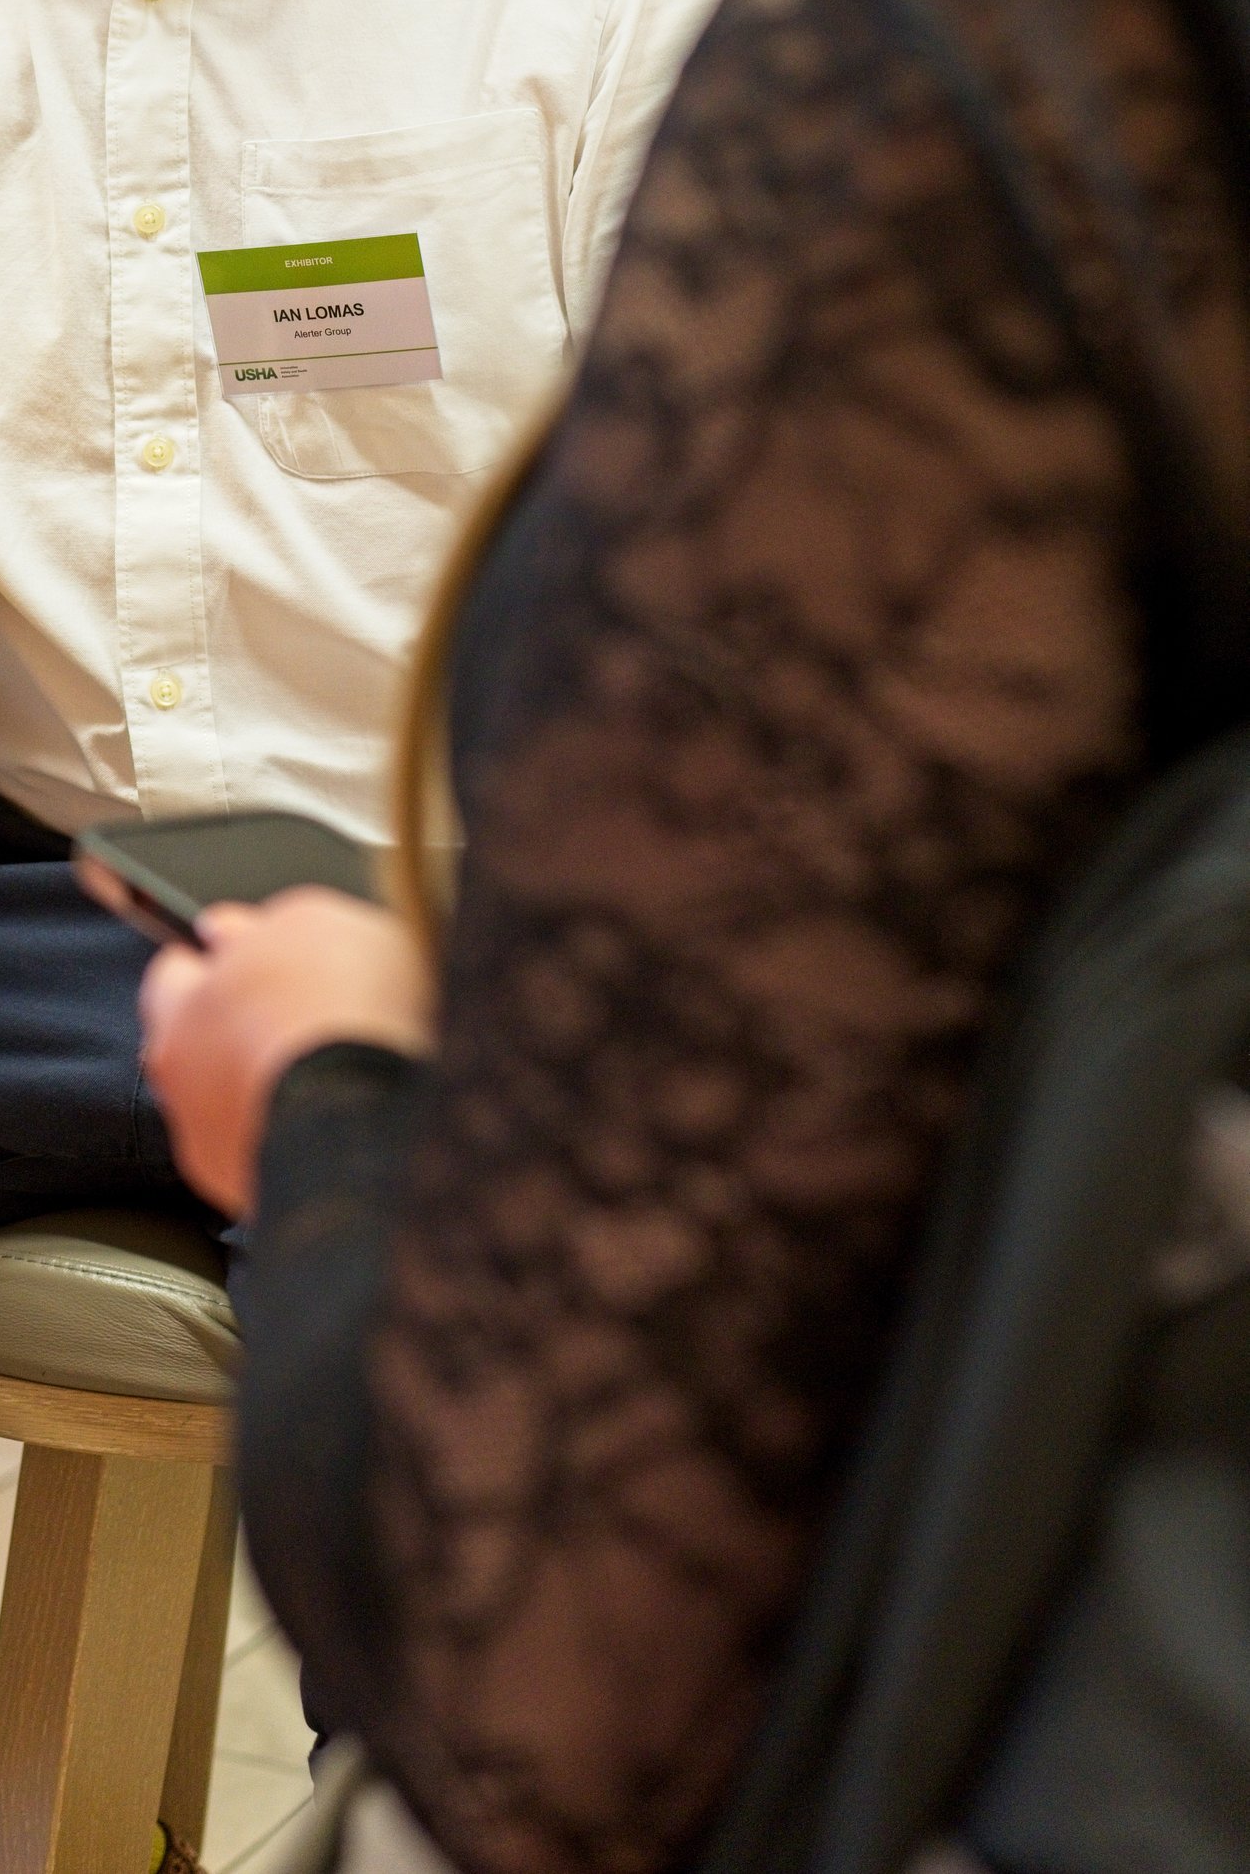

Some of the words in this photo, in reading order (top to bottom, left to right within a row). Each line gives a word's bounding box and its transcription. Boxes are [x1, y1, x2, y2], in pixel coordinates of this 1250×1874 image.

[284, 256, 333, 268] EXHIBITOR
[273, 307, 302, 323] IAN
[305, 303, 365, 320] LOMAS
[294, 329, 323, 339] Alerter
[325, 327, 352, 338] Group
[234, 367, 278, 382] USHA
